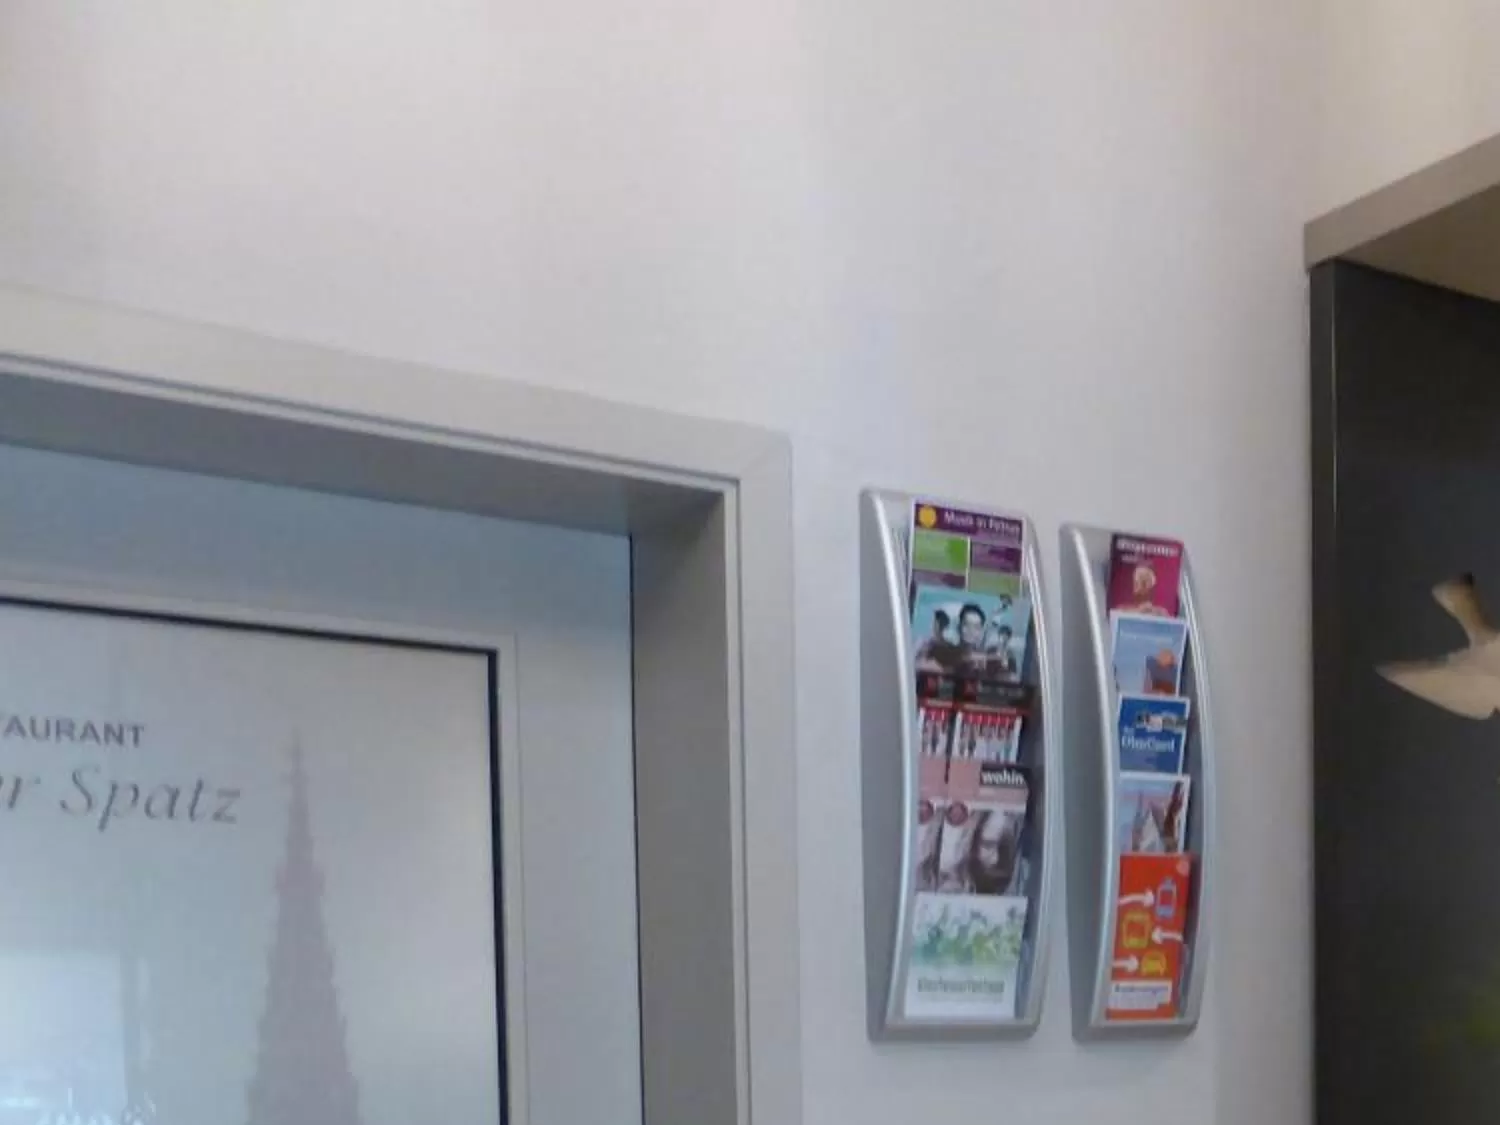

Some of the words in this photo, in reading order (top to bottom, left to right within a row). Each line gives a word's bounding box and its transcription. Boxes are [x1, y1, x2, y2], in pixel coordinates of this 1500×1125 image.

[0, 714, 145, 748] AURANT
[0, 775, 42, 810] r
[58, 763, 242, 833] Spatz
